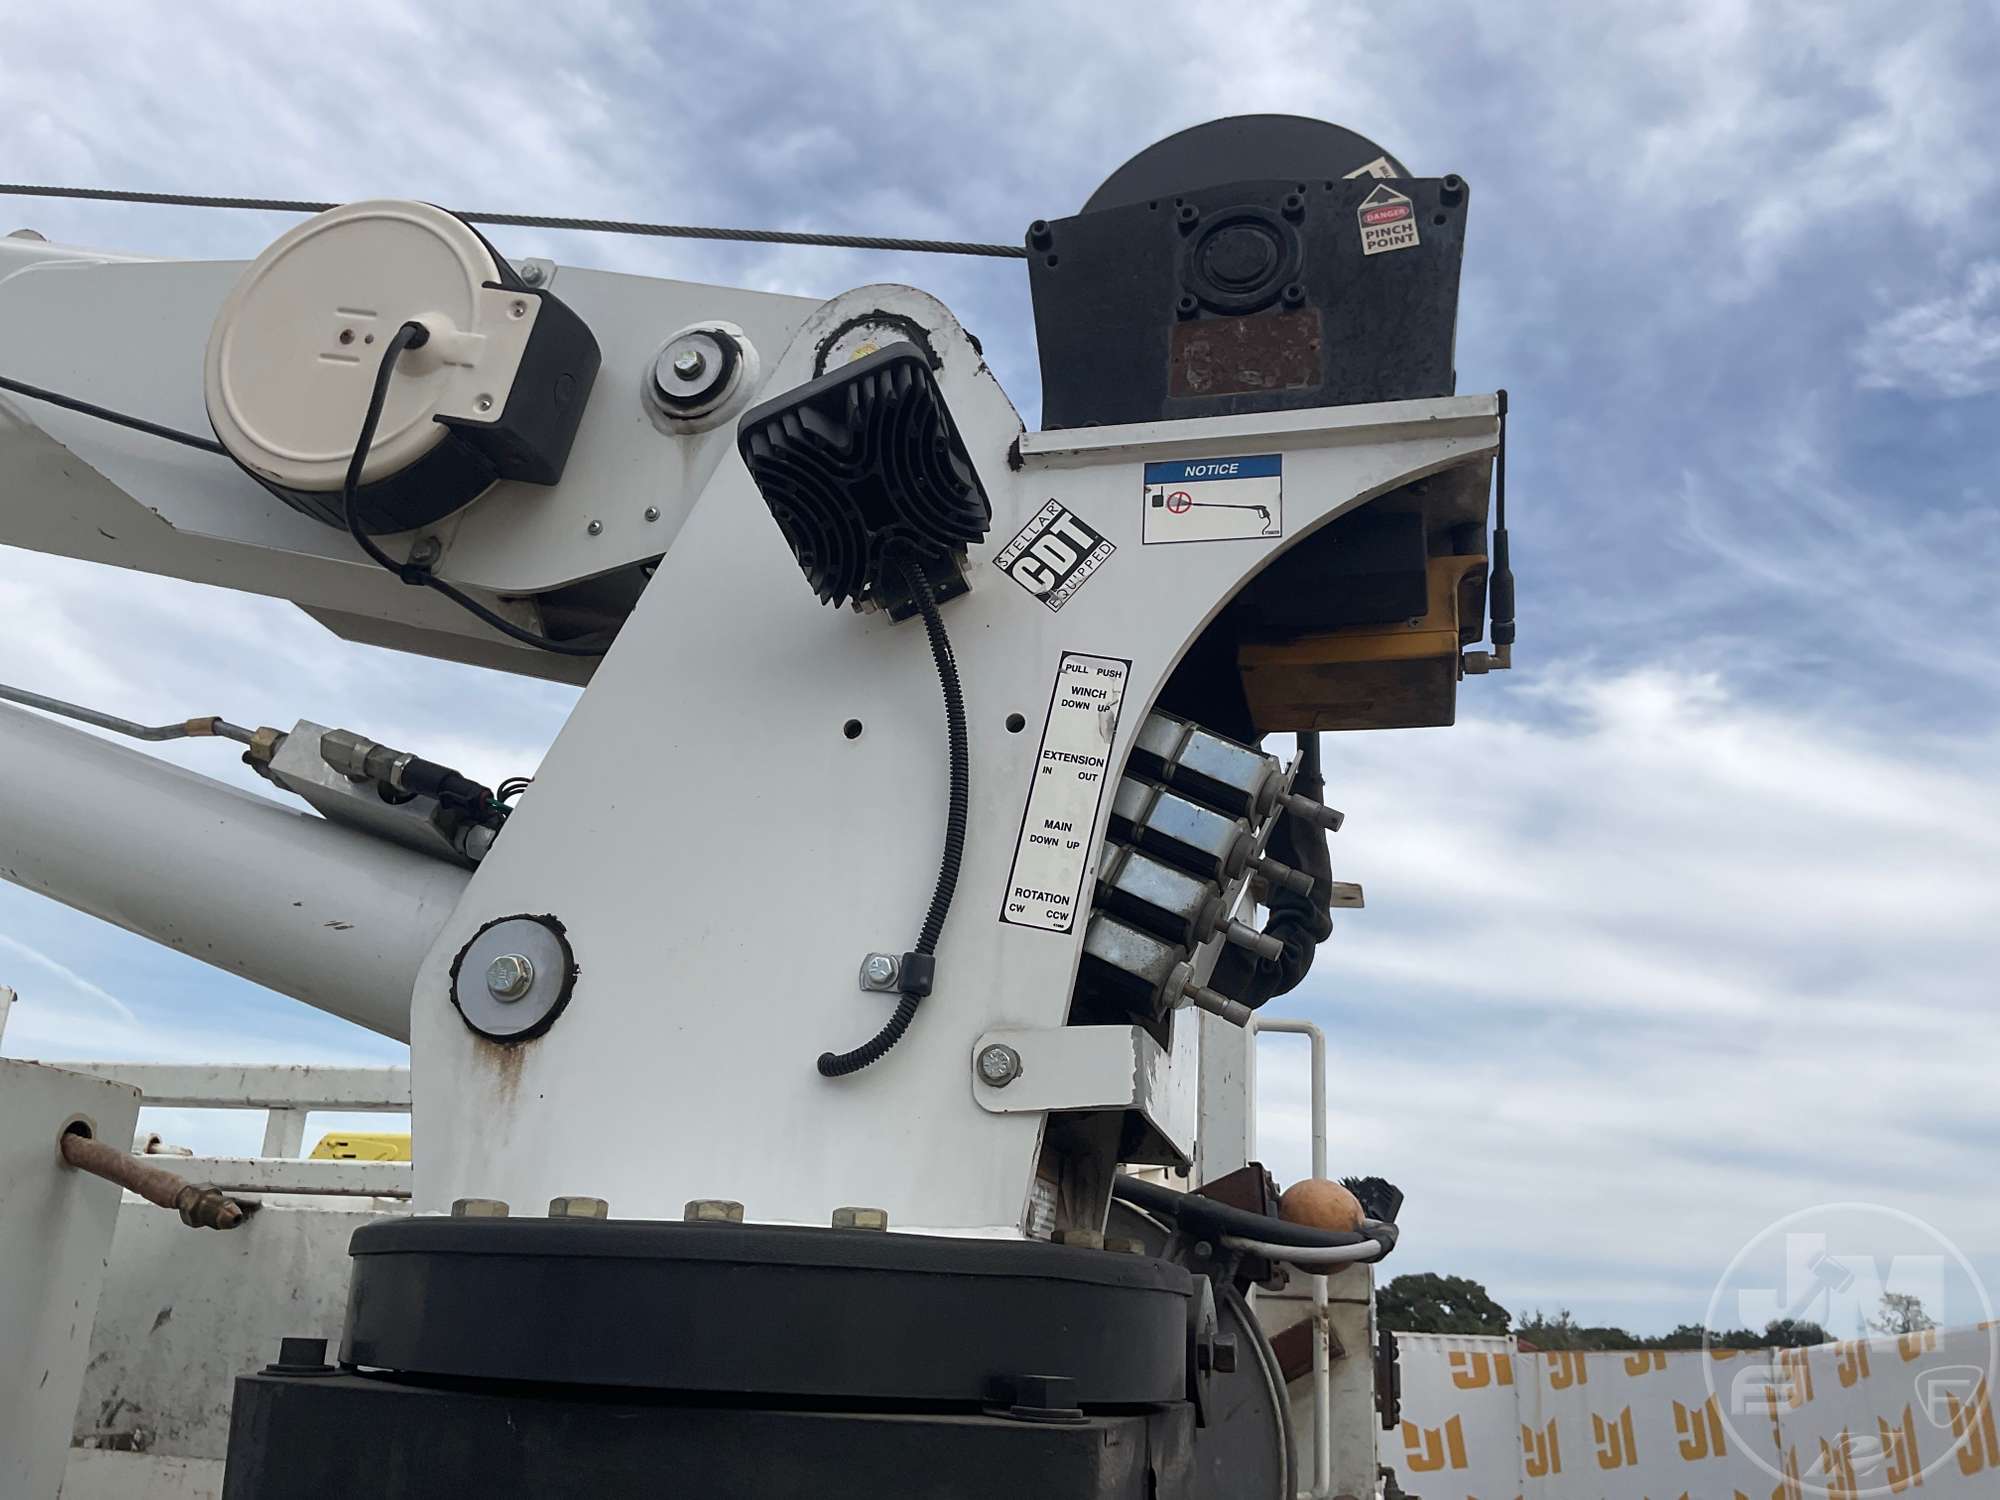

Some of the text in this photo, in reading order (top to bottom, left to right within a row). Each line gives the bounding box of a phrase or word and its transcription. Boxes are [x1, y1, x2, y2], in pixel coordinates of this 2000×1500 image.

[1366, 208, 1406, 222] DANGER
[1365, 223, 1413, 240] PINCH
[1367, 233, 1415, 250] POINT
[1184, 463, 1239, 478] NOTICE
[999, 504, 1059, 567] STELLAR
[1012, 511, 1095, 594] CDT
[1048, 543, 1111, 609] EQUIPPED
[1065, 663, 1122, 679] PULL PUSH
[1071, 685, 1107, 699] WINCH
[1061, 699, 1111, 713] DOWN UP
[1042, 750, 1105, 768] EXTENSION
[1042, 766, 1098, 782] IN OUT
[1044, 819, 1073, 832] MAIN
[1029, 834, 1080, 850] DOWN UP
[1014, 887, 1070, 906] ROTATION
[1009, 903, 1069, 921] CW CCW
